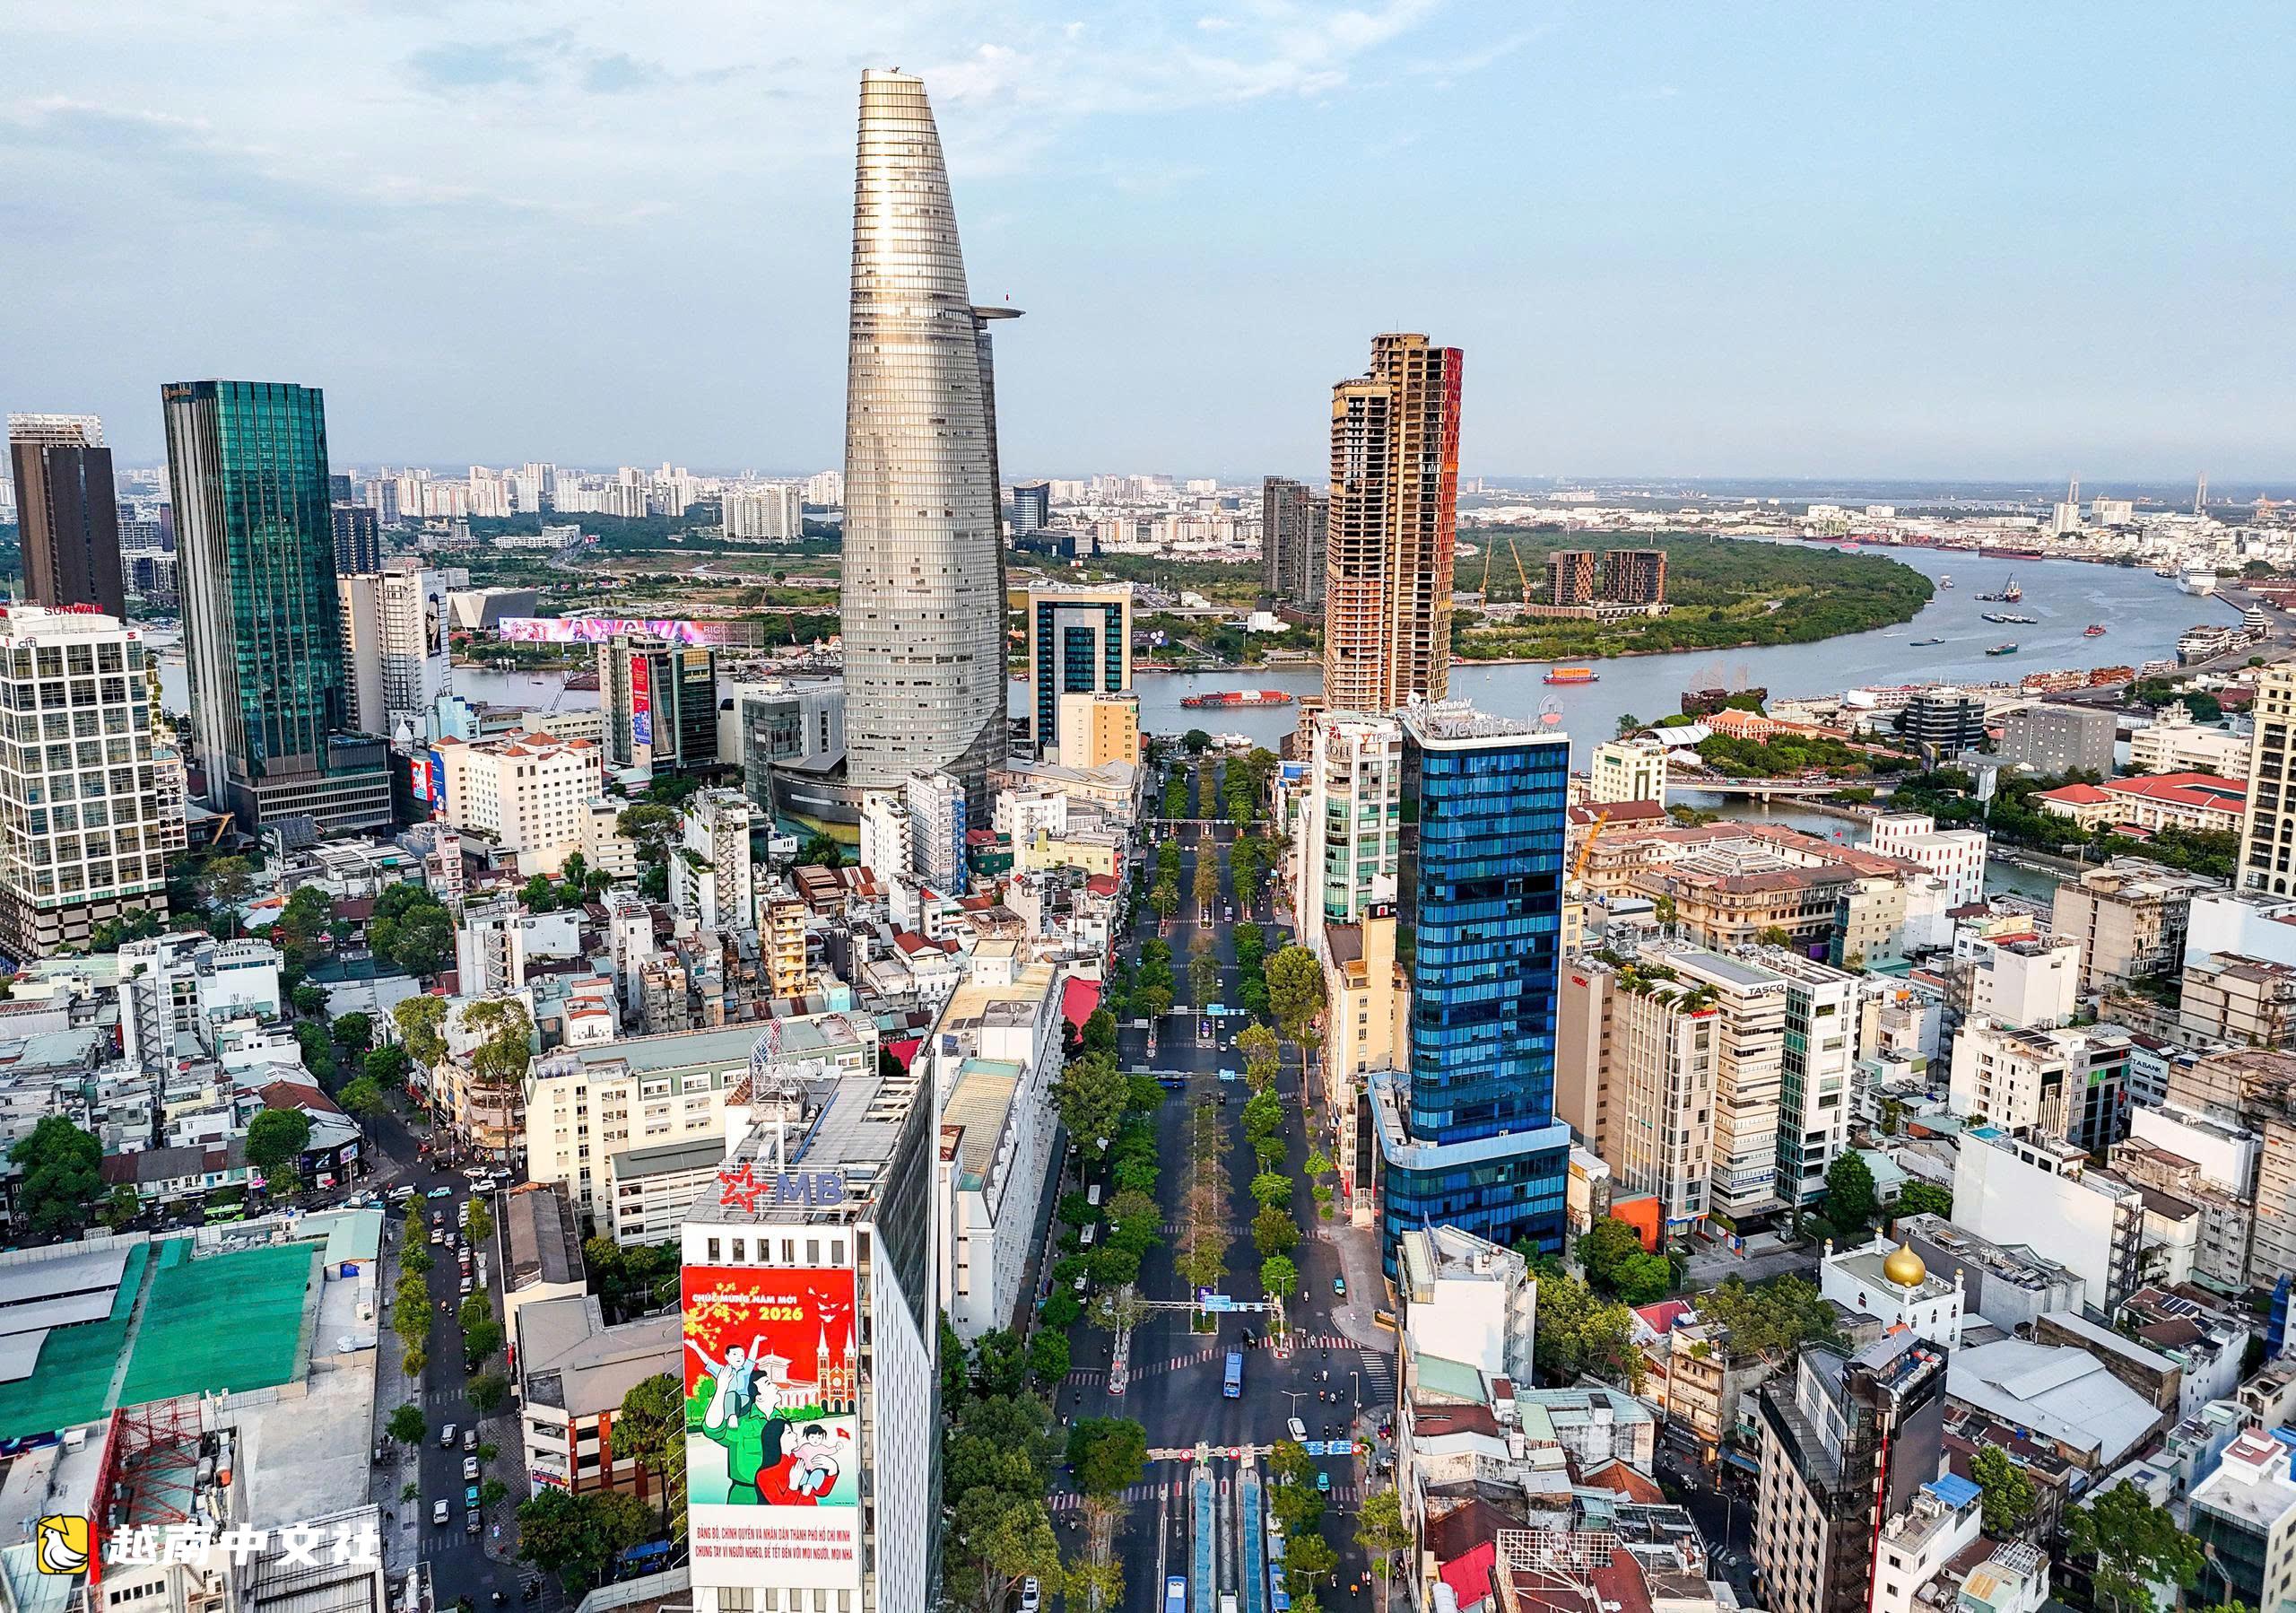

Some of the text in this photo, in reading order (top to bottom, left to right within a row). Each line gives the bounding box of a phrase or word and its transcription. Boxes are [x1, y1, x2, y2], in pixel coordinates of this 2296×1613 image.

[1372, 732, 1401, 743] TPBank
[1748, 983, 1786, 997] TASCO
[775, 1173, 844, 1207] MB
[1751, 1203, 1779, 1215] TASCO
[759, 1306, 804, 1321] 2026
[837, 1530, 850, 1542] MINH
[695, 1545, 713, 1557] CHUNG
[714, 1546, 722, 1557] TAY
